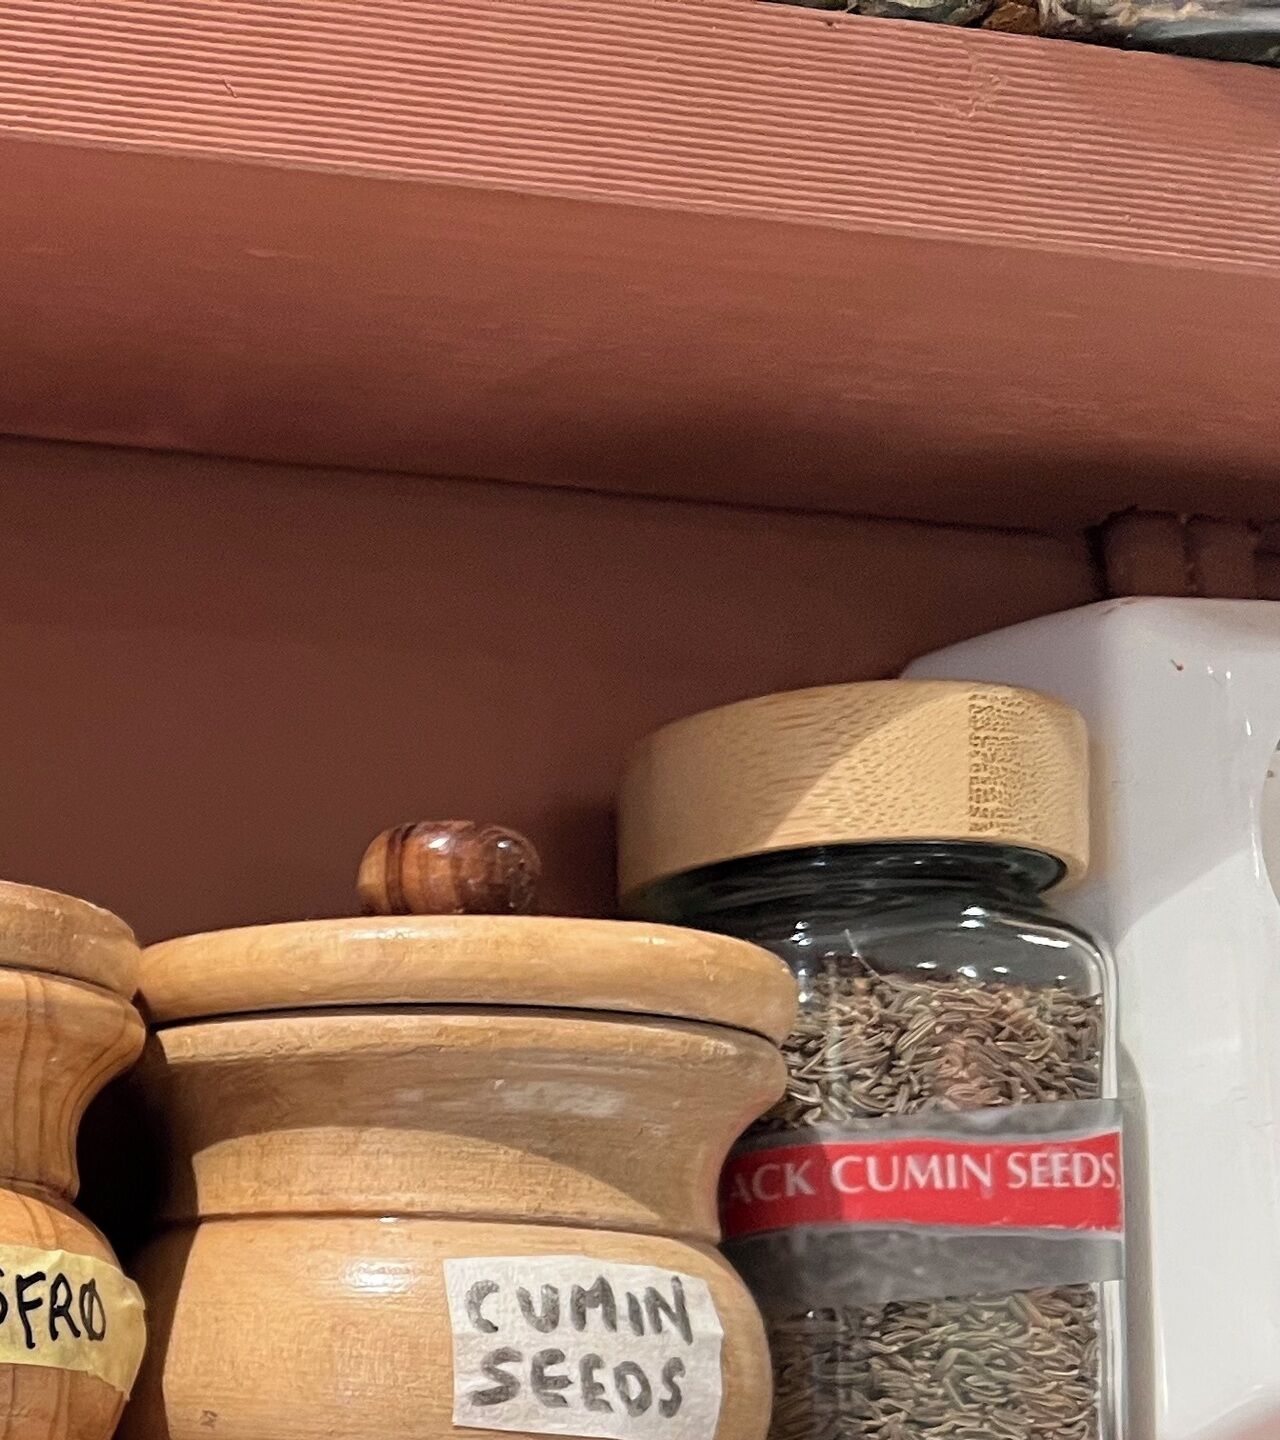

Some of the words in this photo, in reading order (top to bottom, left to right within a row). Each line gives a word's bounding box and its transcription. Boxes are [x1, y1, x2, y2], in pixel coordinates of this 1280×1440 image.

[830, 1152, 994, 1195] CUMIN
[465, 1275, 693, 1346] CUMIN
[469, 1346, 686, 1419] SEEDS
